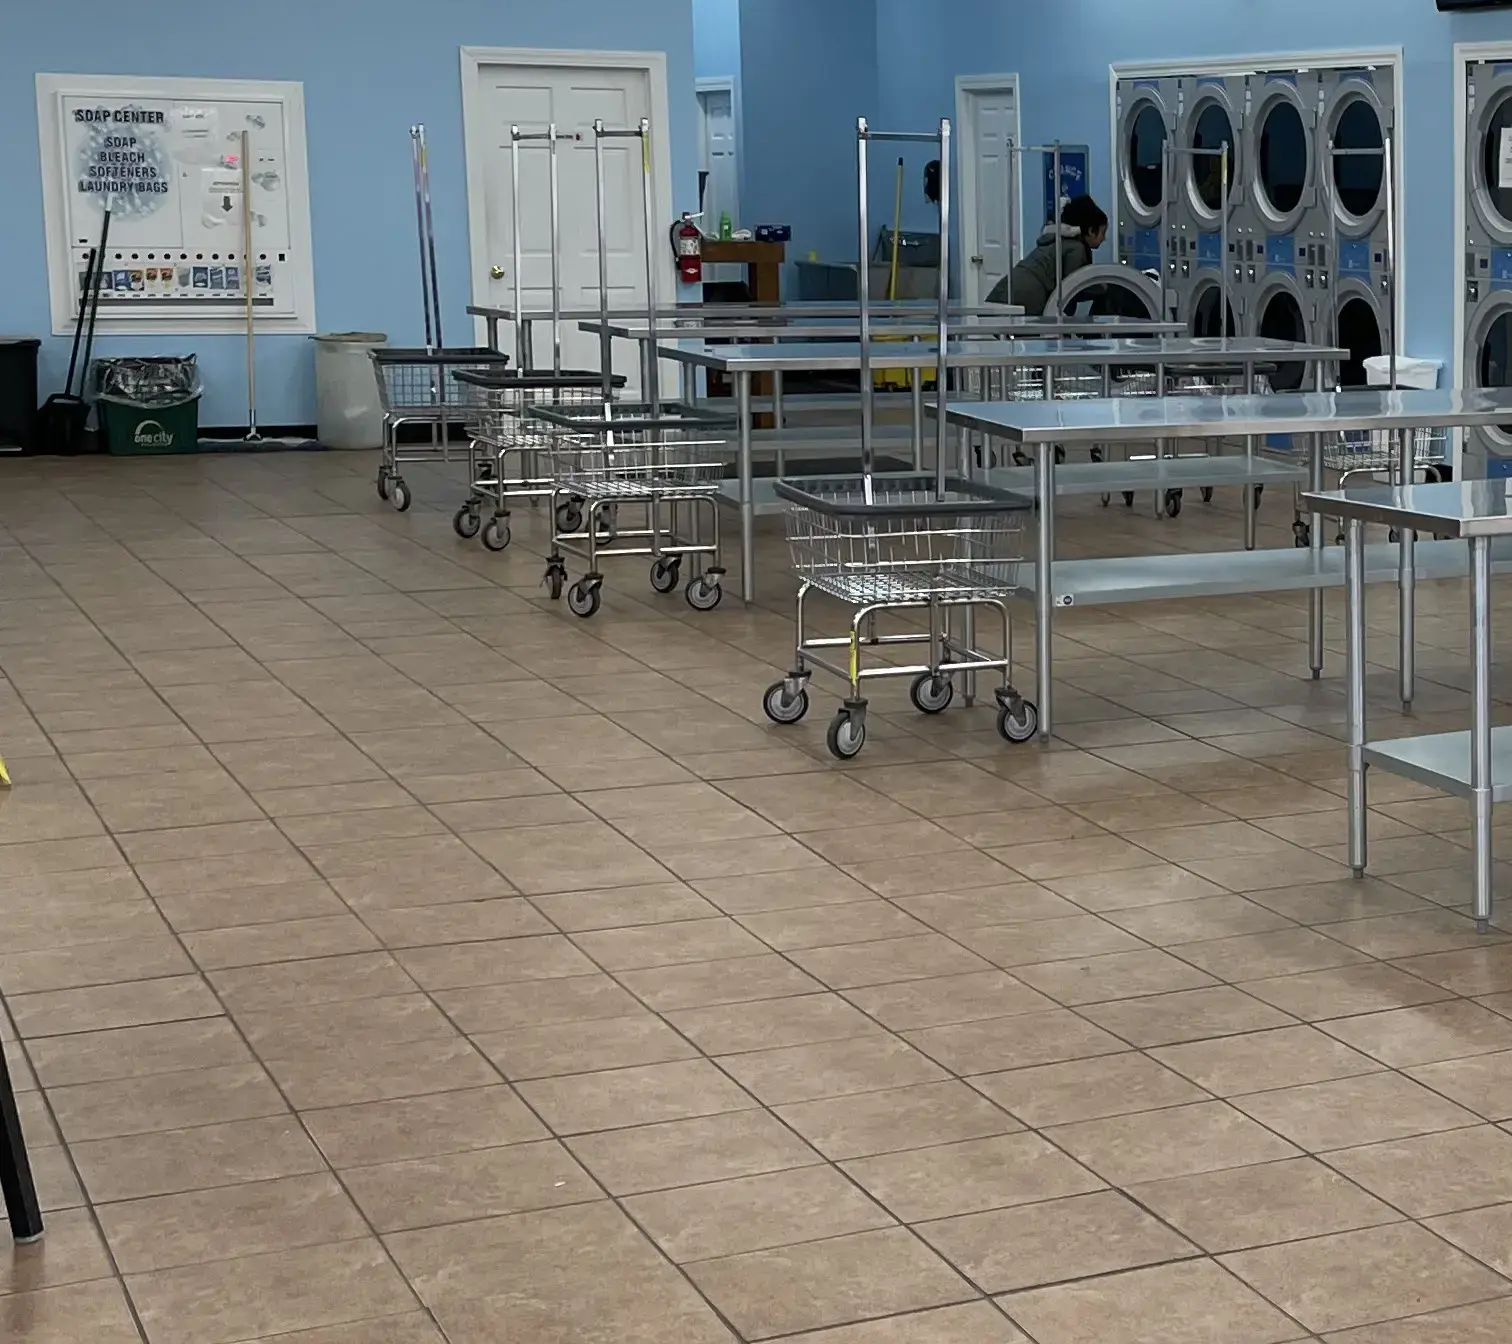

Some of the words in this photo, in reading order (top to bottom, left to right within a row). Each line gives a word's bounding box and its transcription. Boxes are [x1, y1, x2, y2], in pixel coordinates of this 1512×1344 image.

[75, 109, 110, 122] SOAP
[114, 110, 164, 123] CENTER
[104, 137, 136, 148] SOAP
[100, 152, 145, 162] BLEACH
[89, 166, 157, 177] SOFTENERS
[78, 180, 133, 192] LAUNDRY
[138, 182, 168, 193] BAGS
